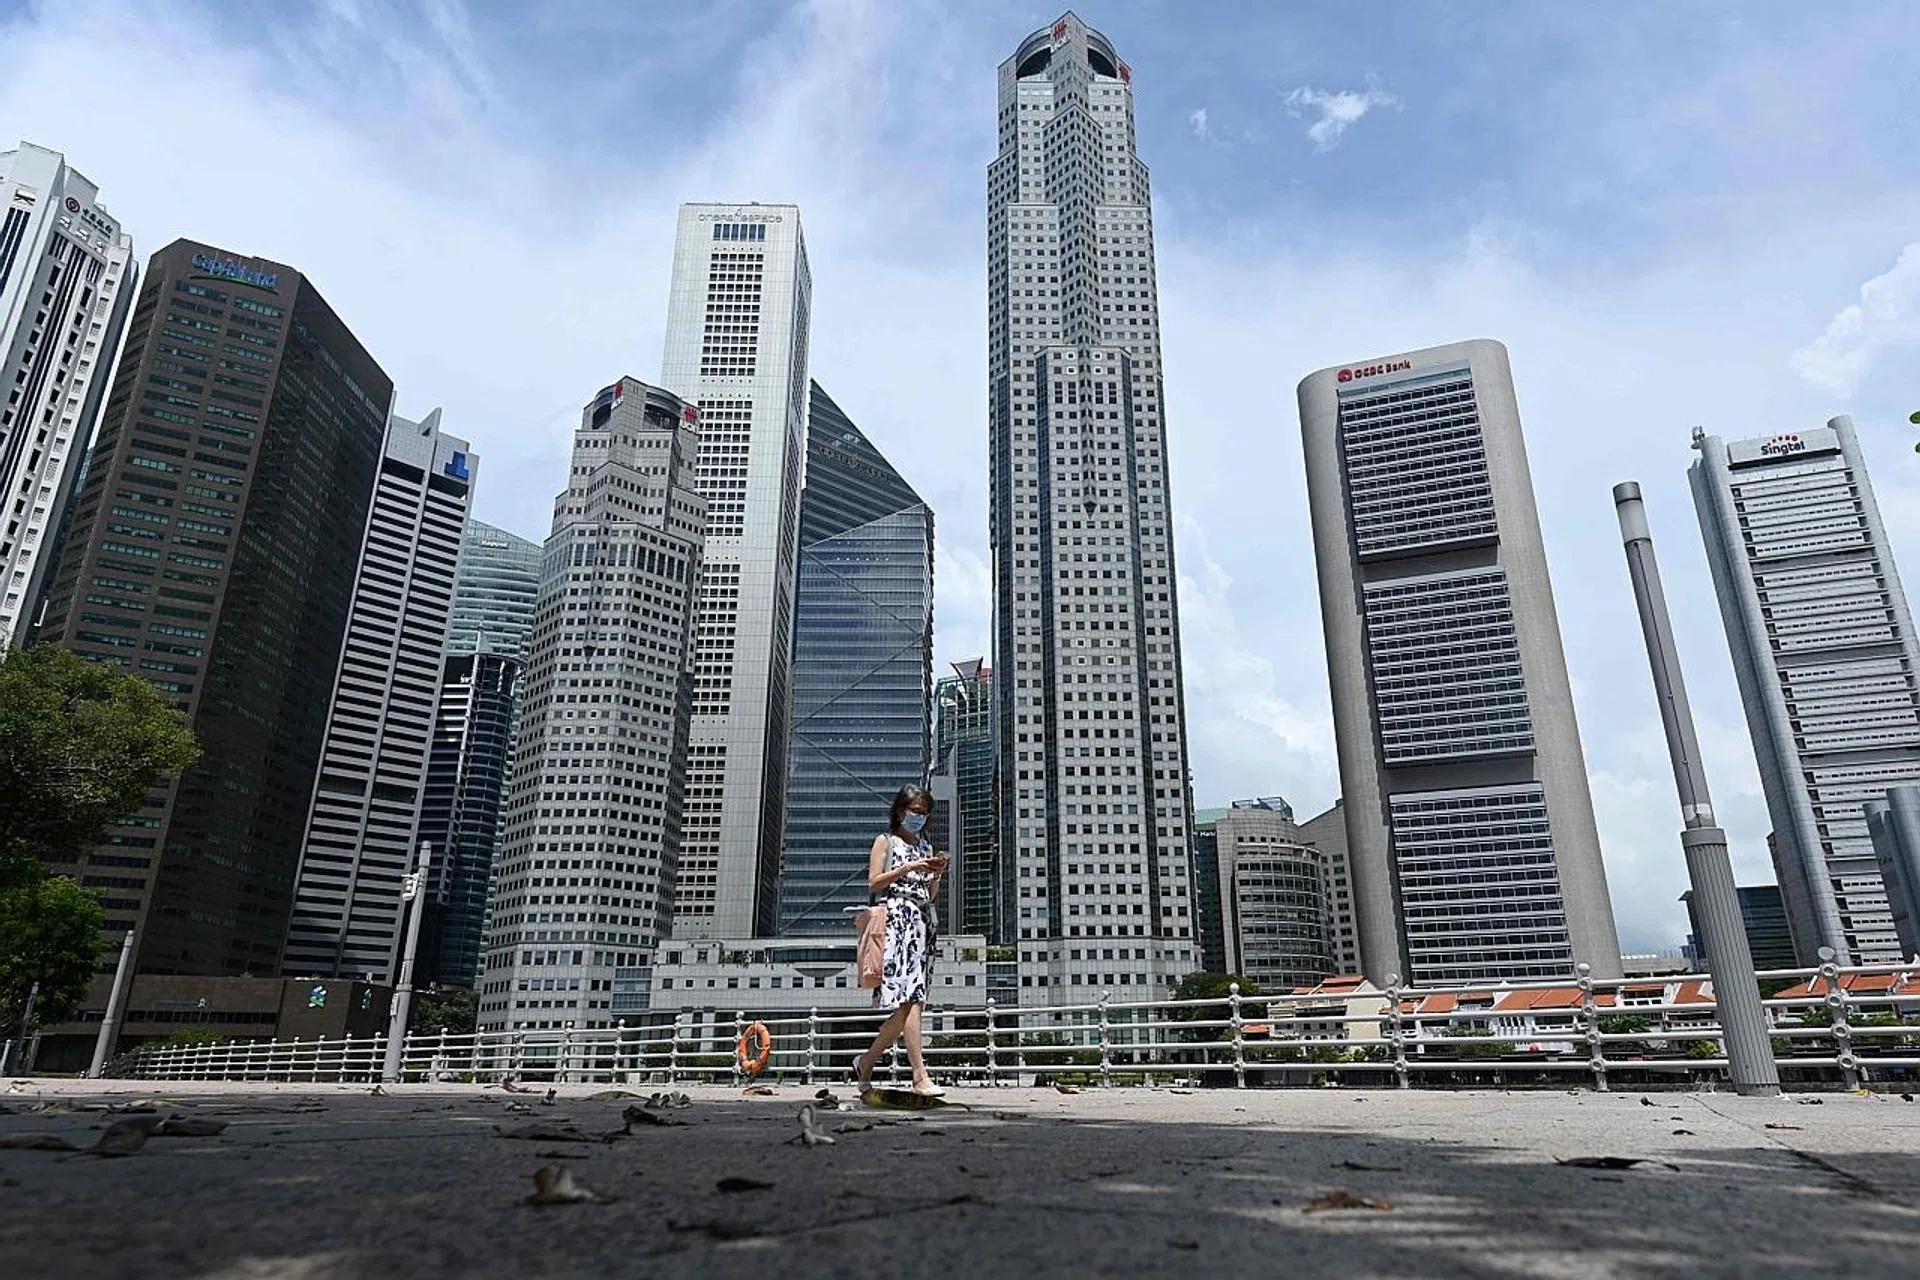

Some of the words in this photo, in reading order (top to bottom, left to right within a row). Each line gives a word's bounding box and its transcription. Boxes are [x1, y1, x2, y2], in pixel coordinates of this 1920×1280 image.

[1354, 364, 1384, 379] OCBC
[1385, 360, 1411, 373] Bank
[1761, 440, 1805, 455] Singtel
